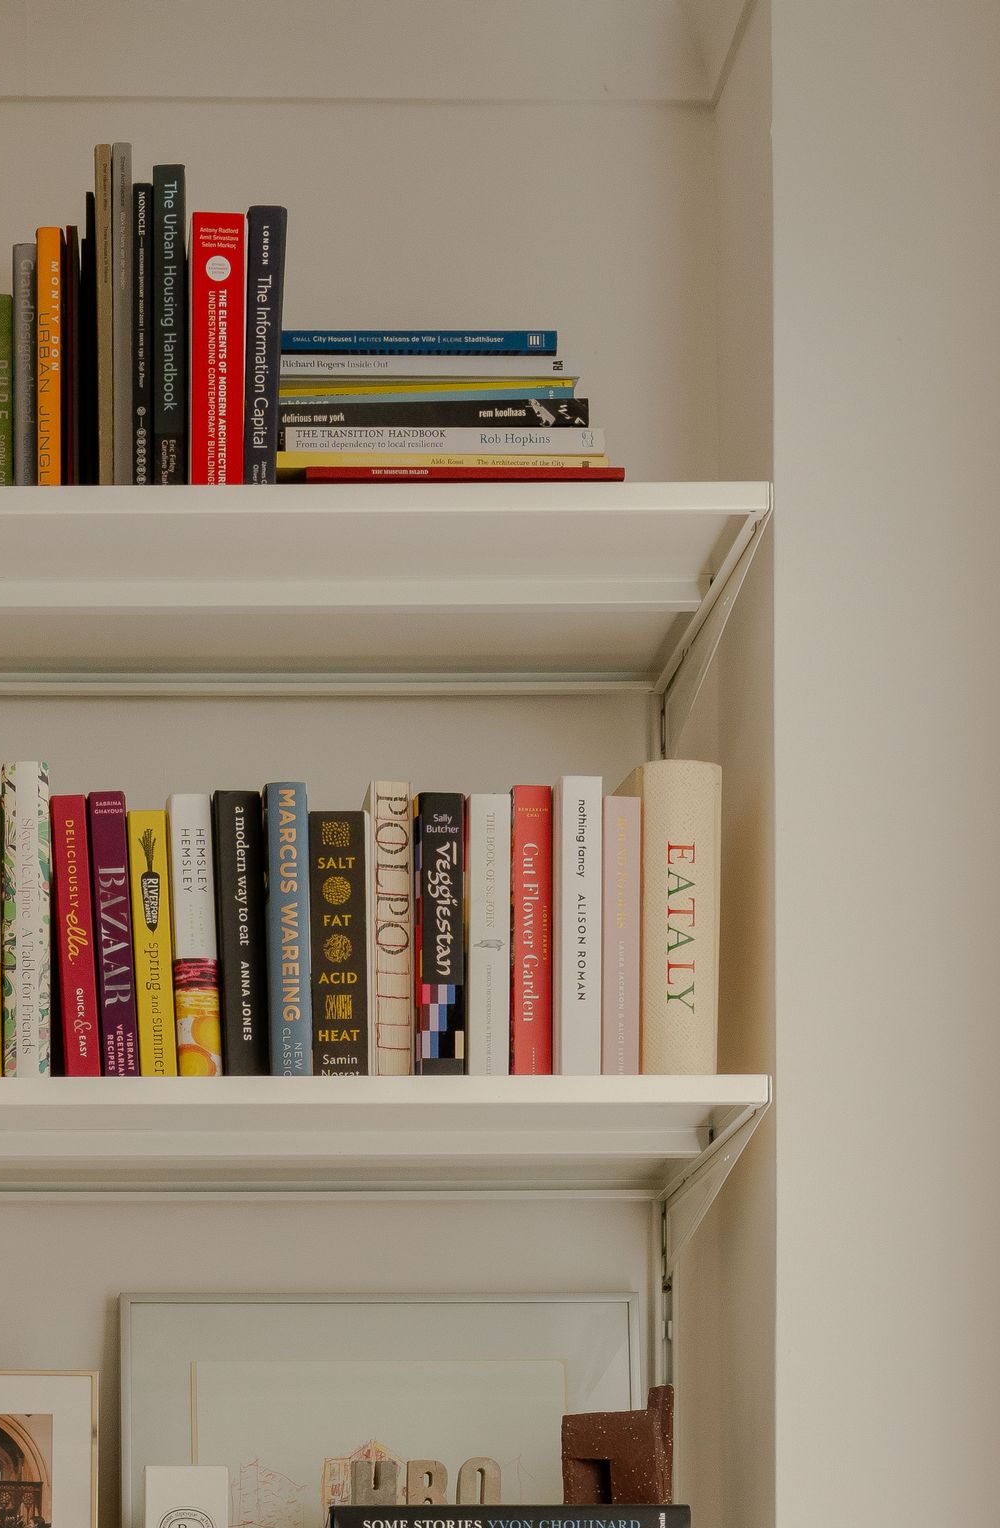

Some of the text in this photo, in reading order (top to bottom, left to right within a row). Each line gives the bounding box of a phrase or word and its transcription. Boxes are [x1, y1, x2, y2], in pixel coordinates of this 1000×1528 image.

[138, 191, 146, 236] MONOCLE
[262, 225, 270, 265] LONDON
[51, 261, 59, 372] MONTY DON
[160, 181, 176, 411] The Urban Housing Handbook
[252, 275, 272, 449] The Information Capital
[282, 412, 345, 424] delirious new york
[296, 429, 448, 438] THE TRANSITION HANDBOOK
[296, 440, 315, 448] From
[319, 440, 330, 448] oil
[331, 440, 376, 450] dependency
[388, 440, 406, 448] local
[407, 440, 444, 448] resilience
[479, 408, 526, 418] rem koolhaas
[479, 433, 551, 446] Rob Hopkins
[234, 806, 249, 945] a modern way to eat
[317, 857, 356, 870] SALT
[576, 799, 588, 878] nothing fancy
[65, 820, 89, 963] DELICIOUSLY ella
[279, 788, 301, 1021] MARCUS WAREING
[323, 915, 352, 926] FAT
[666, 841, 696, 1015] EATALY
[98, 864, 132, 1008] BAZAAR
[521, 842, 540, 1023] Cut Flower Garden
[577, 894, 587, 1001] ALISON ROMAN
[240, 961, 252, 1041] ANNA JONES
[318, 972, 358, 985] ACID
[318, 1030, 359, 1042] HEAT
